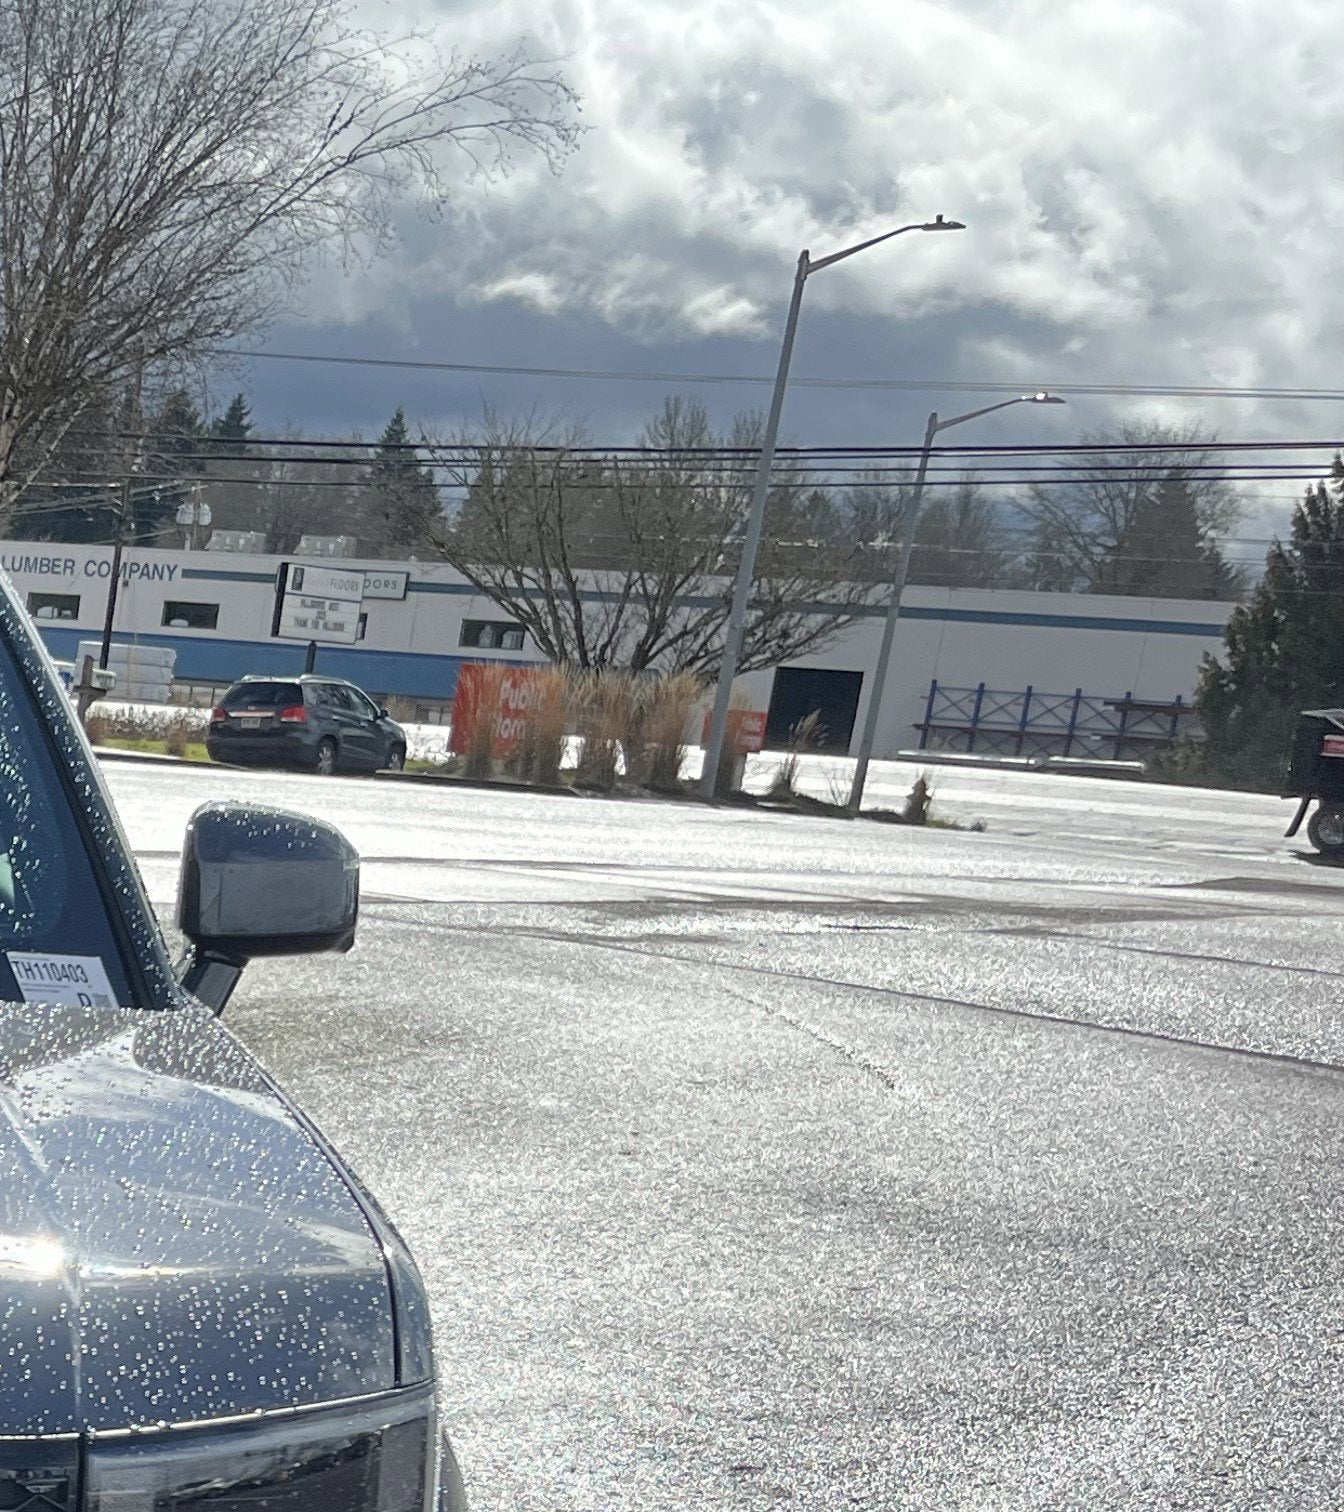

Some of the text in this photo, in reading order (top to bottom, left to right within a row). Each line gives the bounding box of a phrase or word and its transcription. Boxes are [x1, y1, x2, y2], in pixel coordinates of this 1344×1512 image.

[1, 555, 178, 581] LUMBER COMPANY
[11, 961, 88, 983] TH110403
